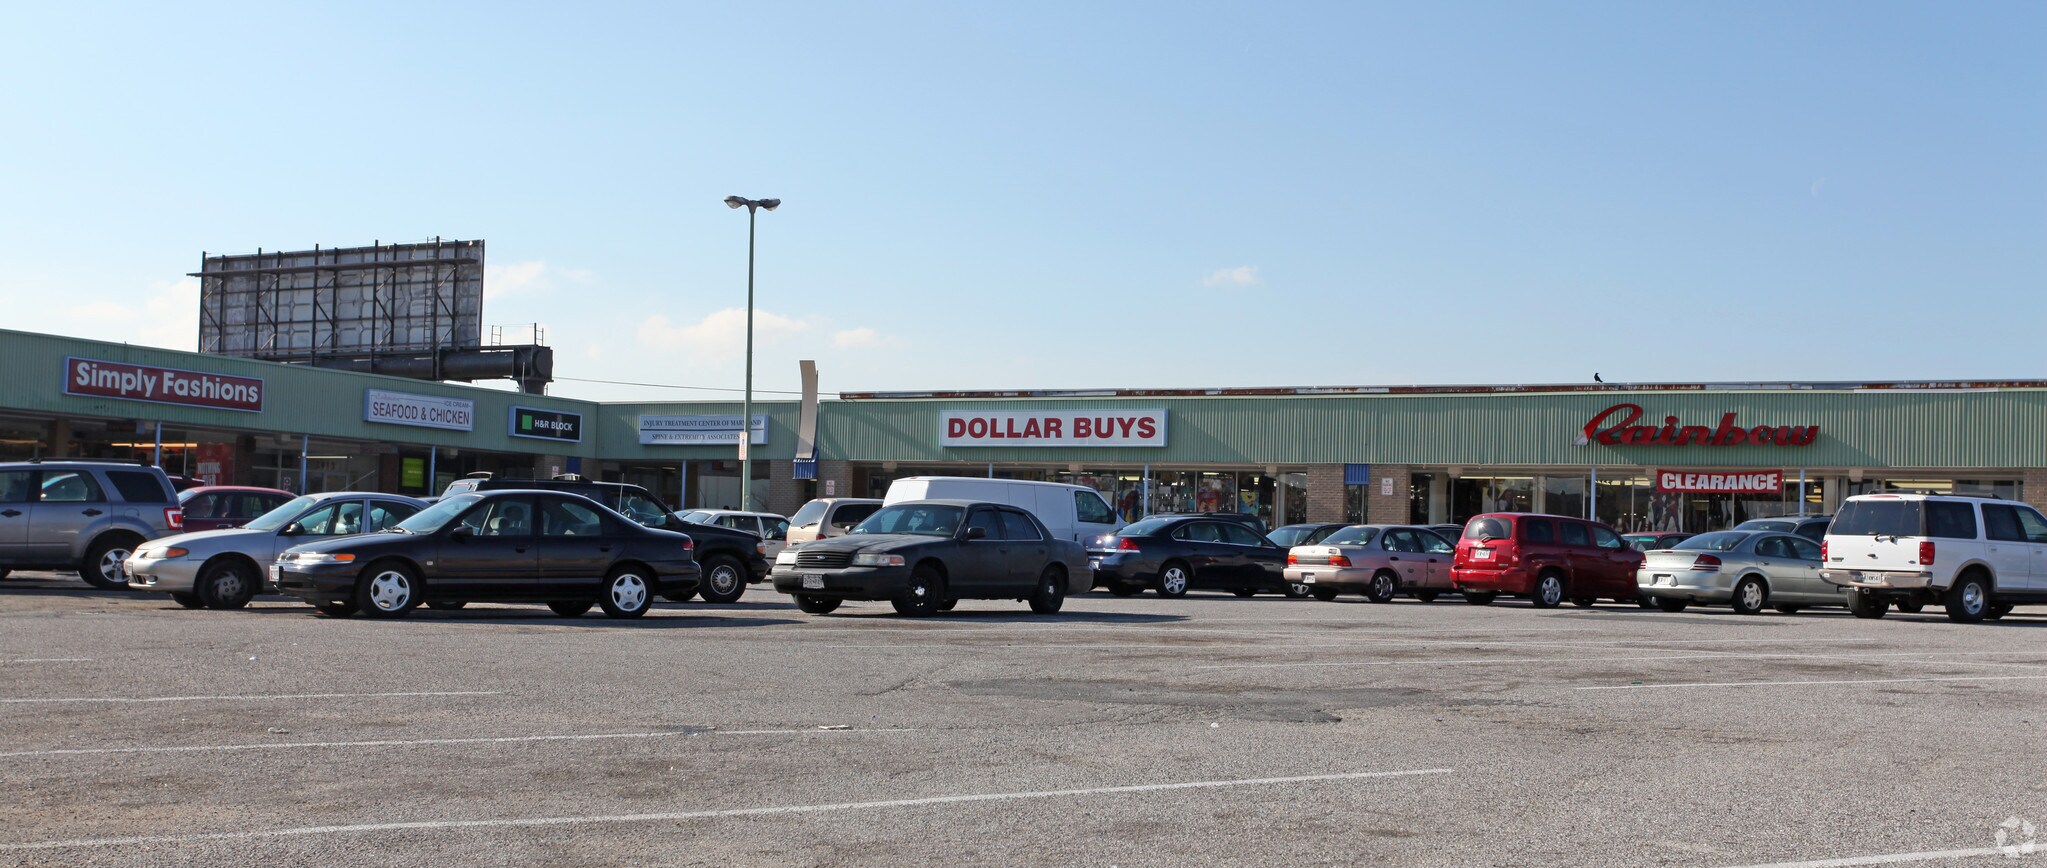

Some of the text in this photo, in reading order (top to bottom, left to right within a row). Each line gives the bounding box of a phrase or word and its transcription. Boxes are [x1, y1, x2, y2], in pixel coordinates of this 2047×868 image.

[76, 362, 258, 403] Simply Fashions
[373, 402, 470, 425] SEAFOOD & CHICKEN
[534, 419, 573, 431] H&R BLOCK
[643, 420, 663, 428] INJURY
[947, 417, 1156, 439] DOLLAR BUYS
[1571, 403, 1820, 447] Rainbow
[674, 433, 705, 441] EXTREMITY
[1661, 472, 1778, 490] CLEARANCE
